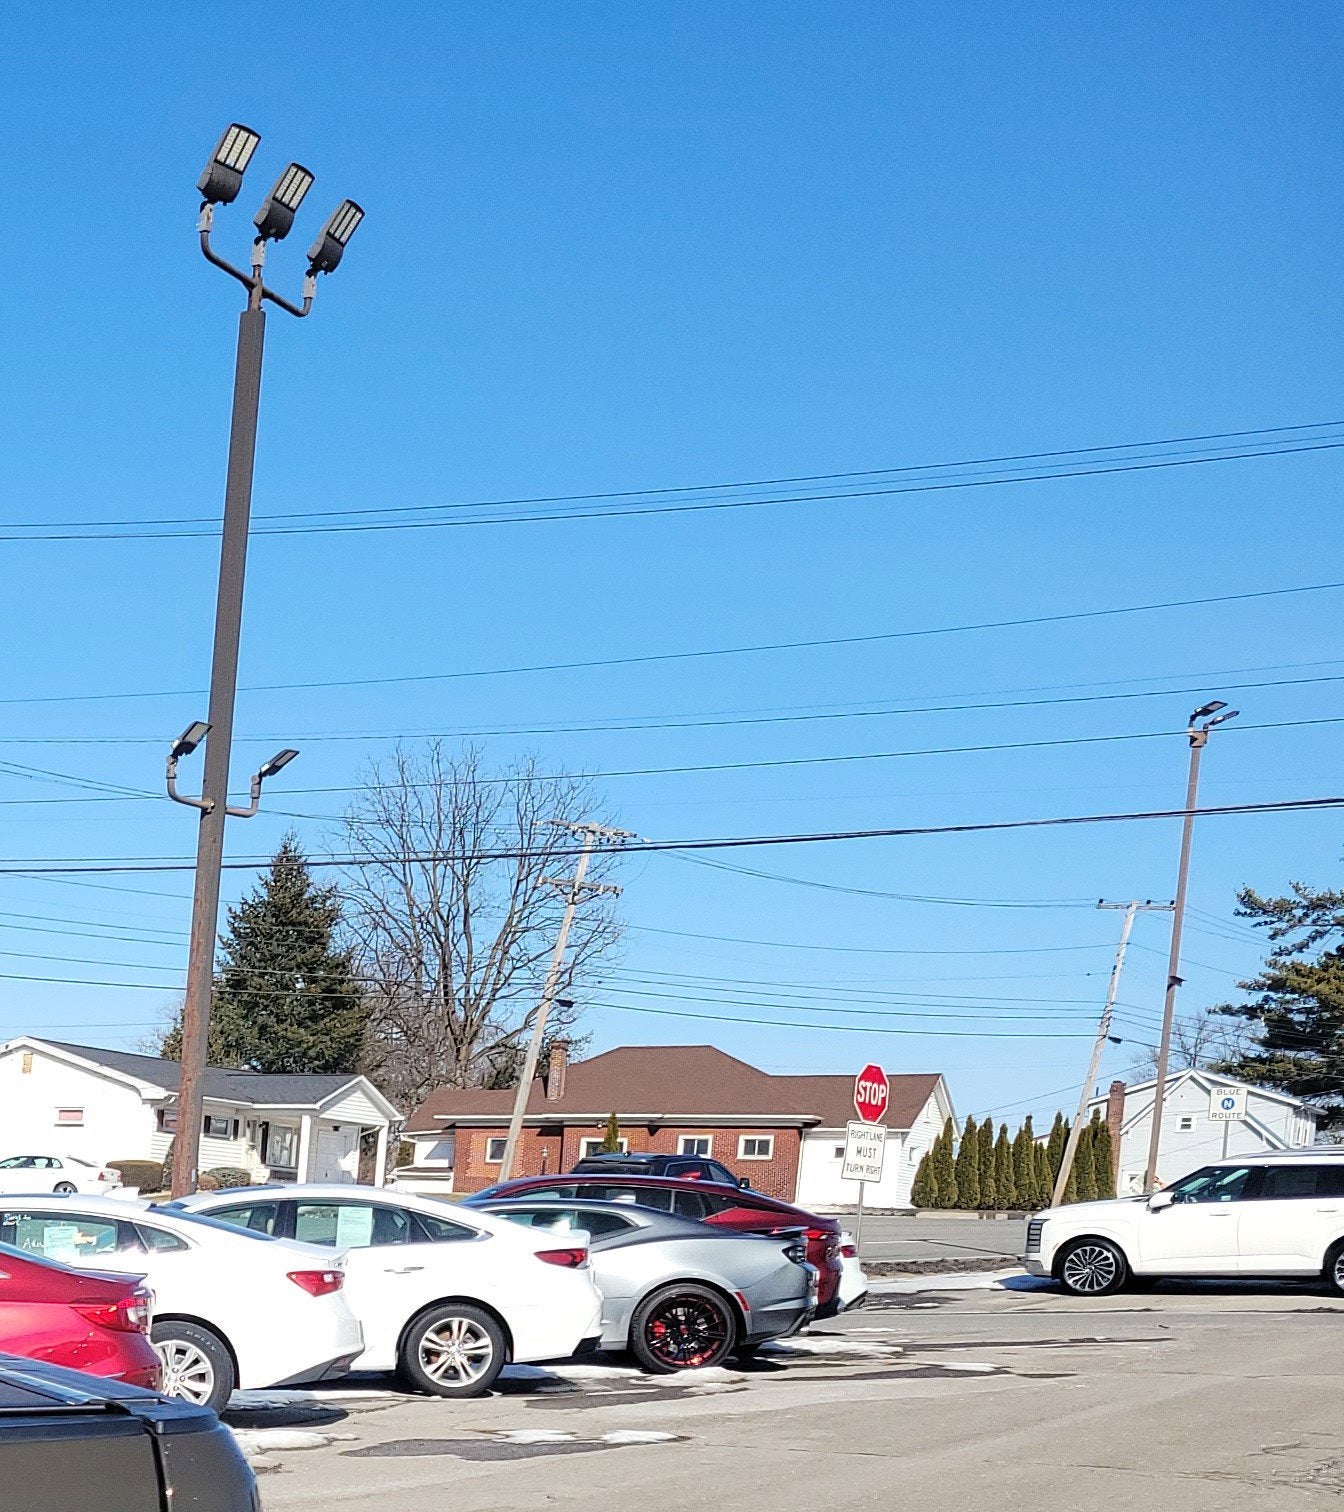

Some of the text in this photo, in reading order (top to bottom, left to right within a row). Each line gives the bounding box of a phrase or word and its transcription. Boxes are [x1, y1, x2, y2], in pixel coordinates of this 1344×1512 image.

[857, 1080, 887, 1106] STOP
[1223, 1099, 1232, 1109] N
[850, 1129, 883, 1142] RIGHT LANE
[855, 1145, 877, 1158] MUST
[846, 1163, 881, 1175] TURN RIGHT
